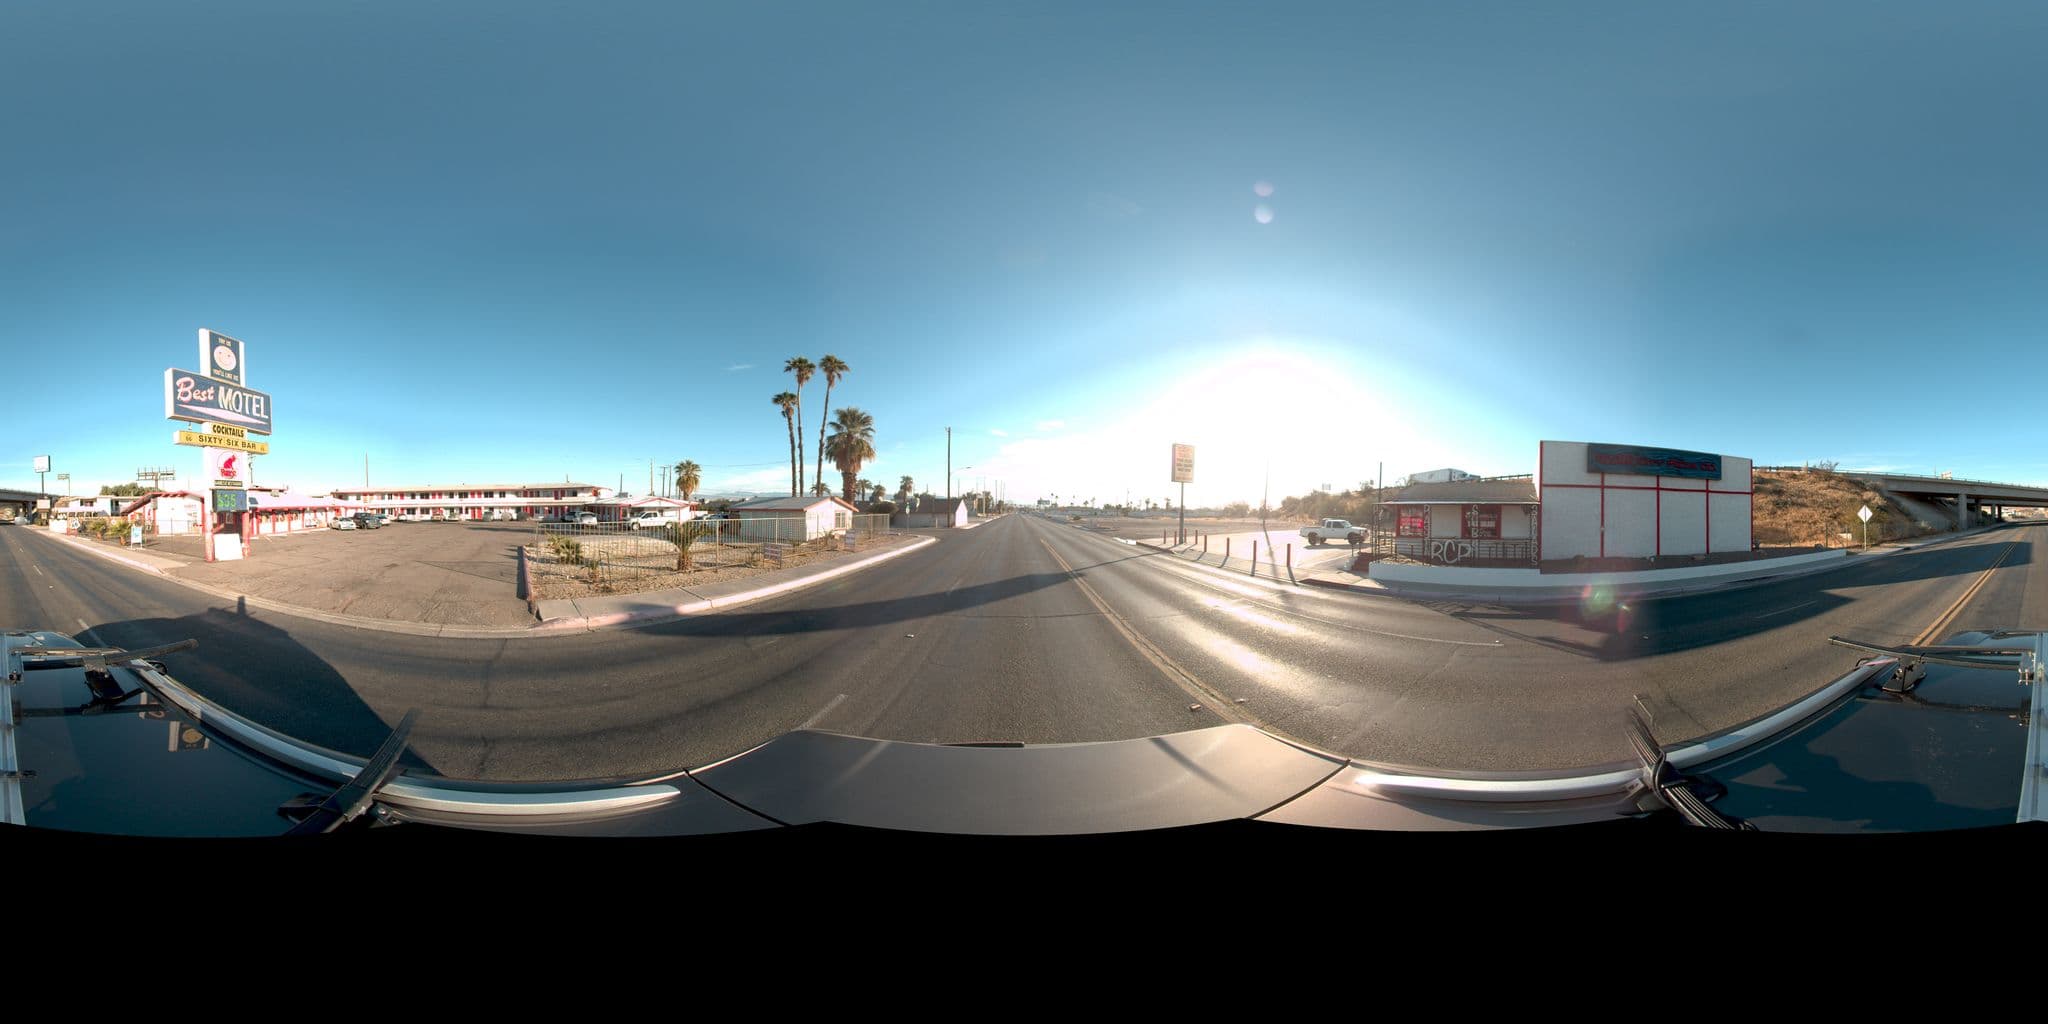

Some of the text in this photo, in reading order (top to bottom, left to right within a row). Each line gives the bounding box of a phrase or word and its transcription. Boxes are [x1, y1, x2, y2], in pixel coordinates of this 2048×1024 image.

[176, 377, 269, 419] Best MOTEL
[212, 424, 244, 438] COCKTAILS
[198, 435, 222, 445] SIXTY
[226, 438, 239, 447] SIX
[241, 441, 256, 450] BAR
[1431, 540, 1472, 564] RCP
